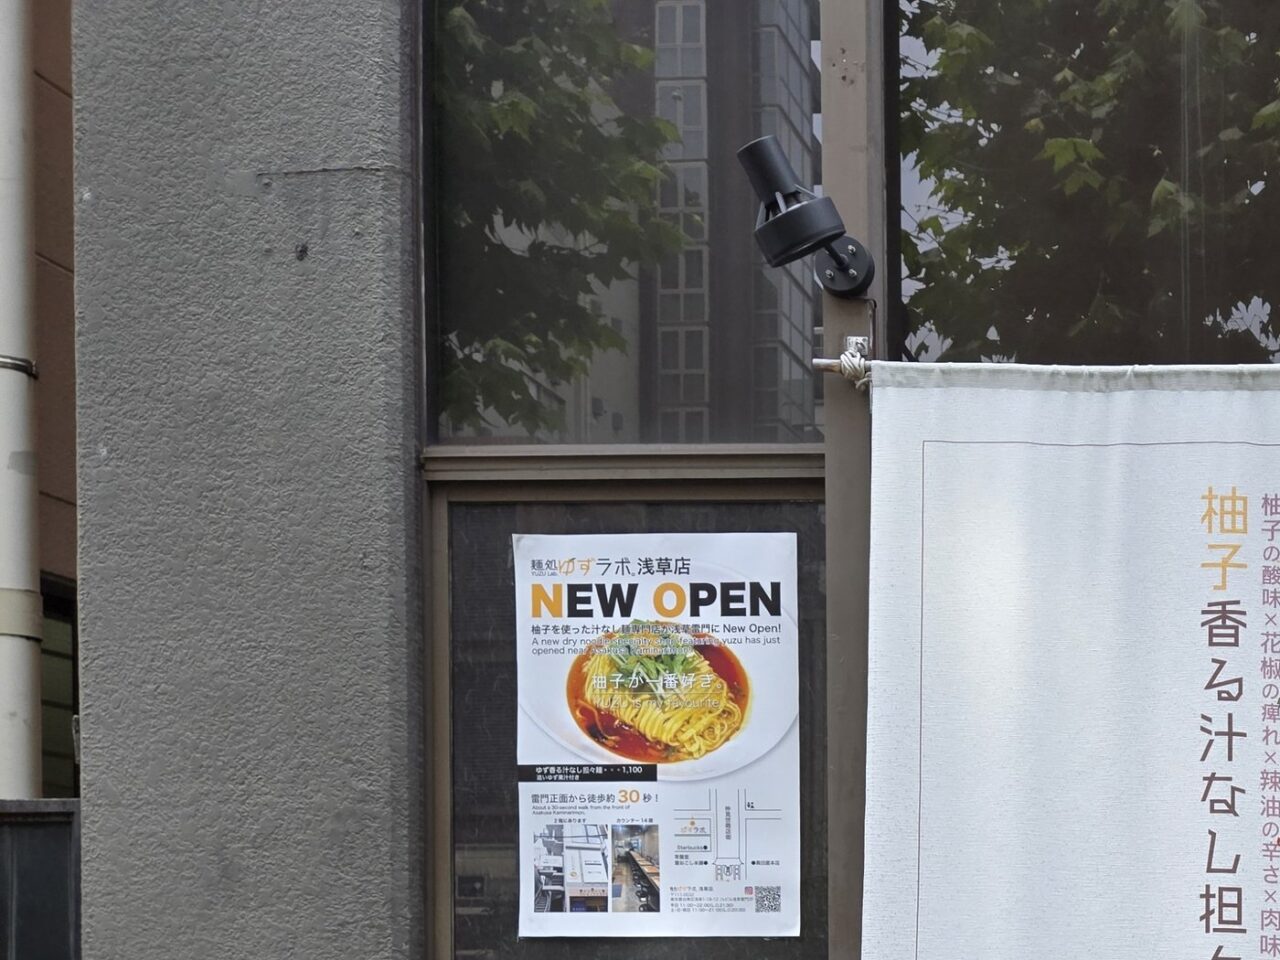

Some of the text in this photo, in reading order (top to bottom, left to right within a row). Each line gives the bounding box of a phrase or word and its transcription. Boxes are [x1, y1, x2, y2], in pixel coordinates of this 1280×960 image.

[531, 581, 782, 618] NEW OPEN
[723, 624, 745, 633] New
[749, 623, 782, 634] Open!
[531, 637, 539, 645] A
[541, 638, 560, 646] new
[562, 637, 578, 647] dry
[722, 637, 743, 646] yuzu
[745, 635, 761, 644] has
[762, 635, 781, 646] just
[531, 646, 565, 656] opened
[618, 789, 640, 804] 30
